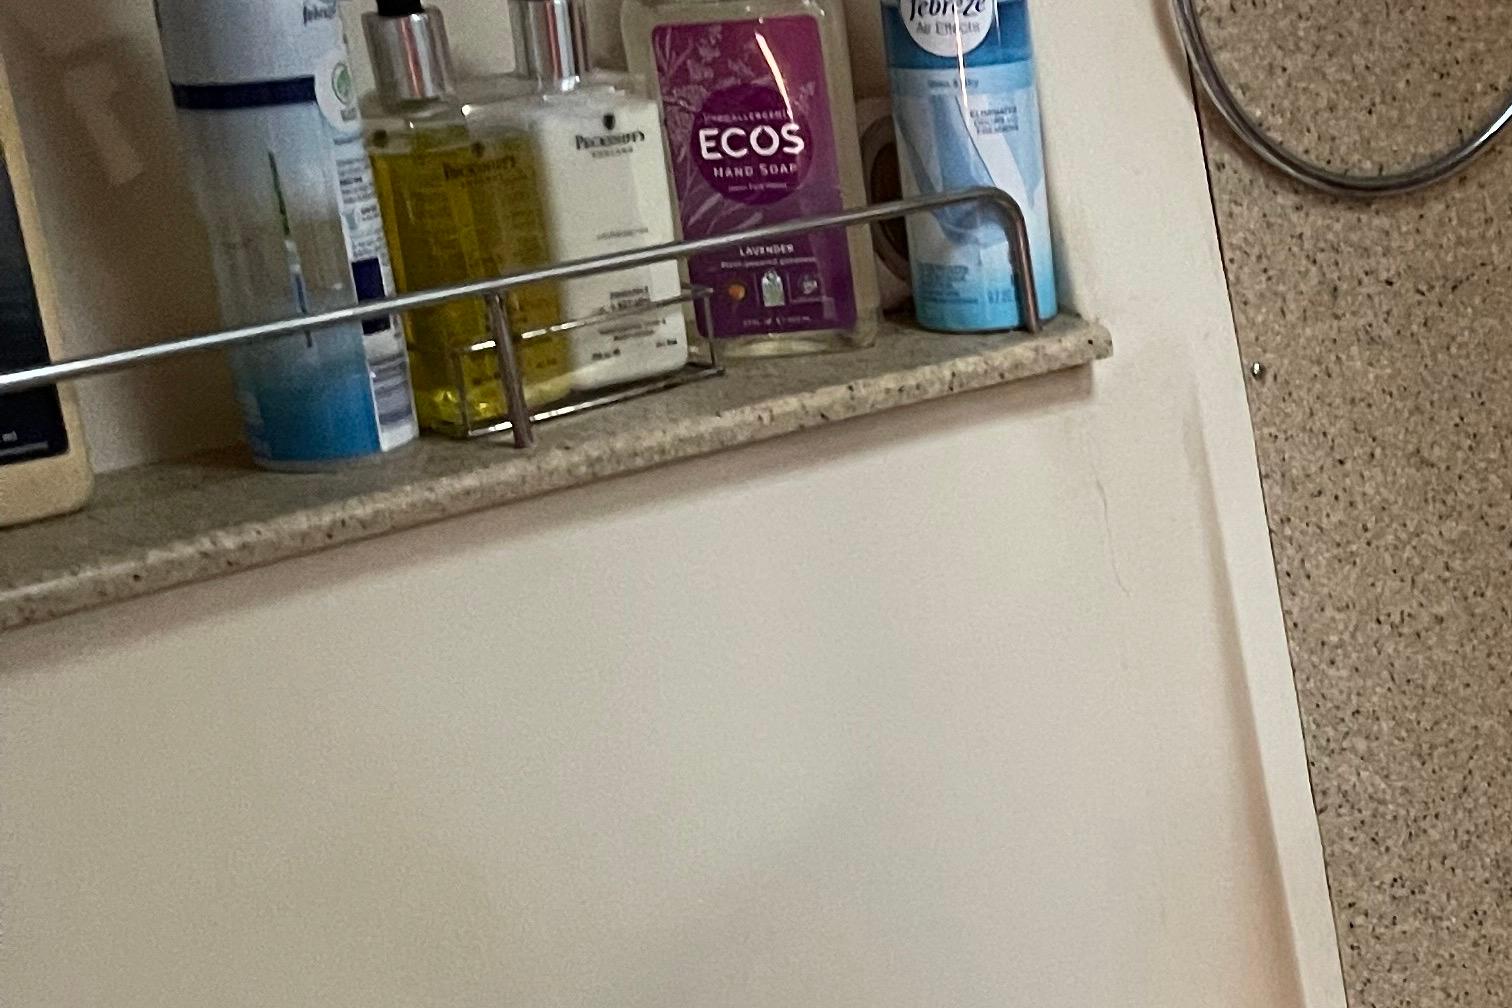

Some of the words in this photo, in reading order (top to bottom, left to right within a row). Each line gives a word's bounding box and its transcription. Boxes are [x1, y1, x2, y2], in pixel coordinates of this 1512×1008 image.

[699, 122, 805, 160] ECOS
[713, 165, 754, 178] HAND
[759, 162, 798, 176] SOAP
[739, 243, 794, 257] LAVENDER
